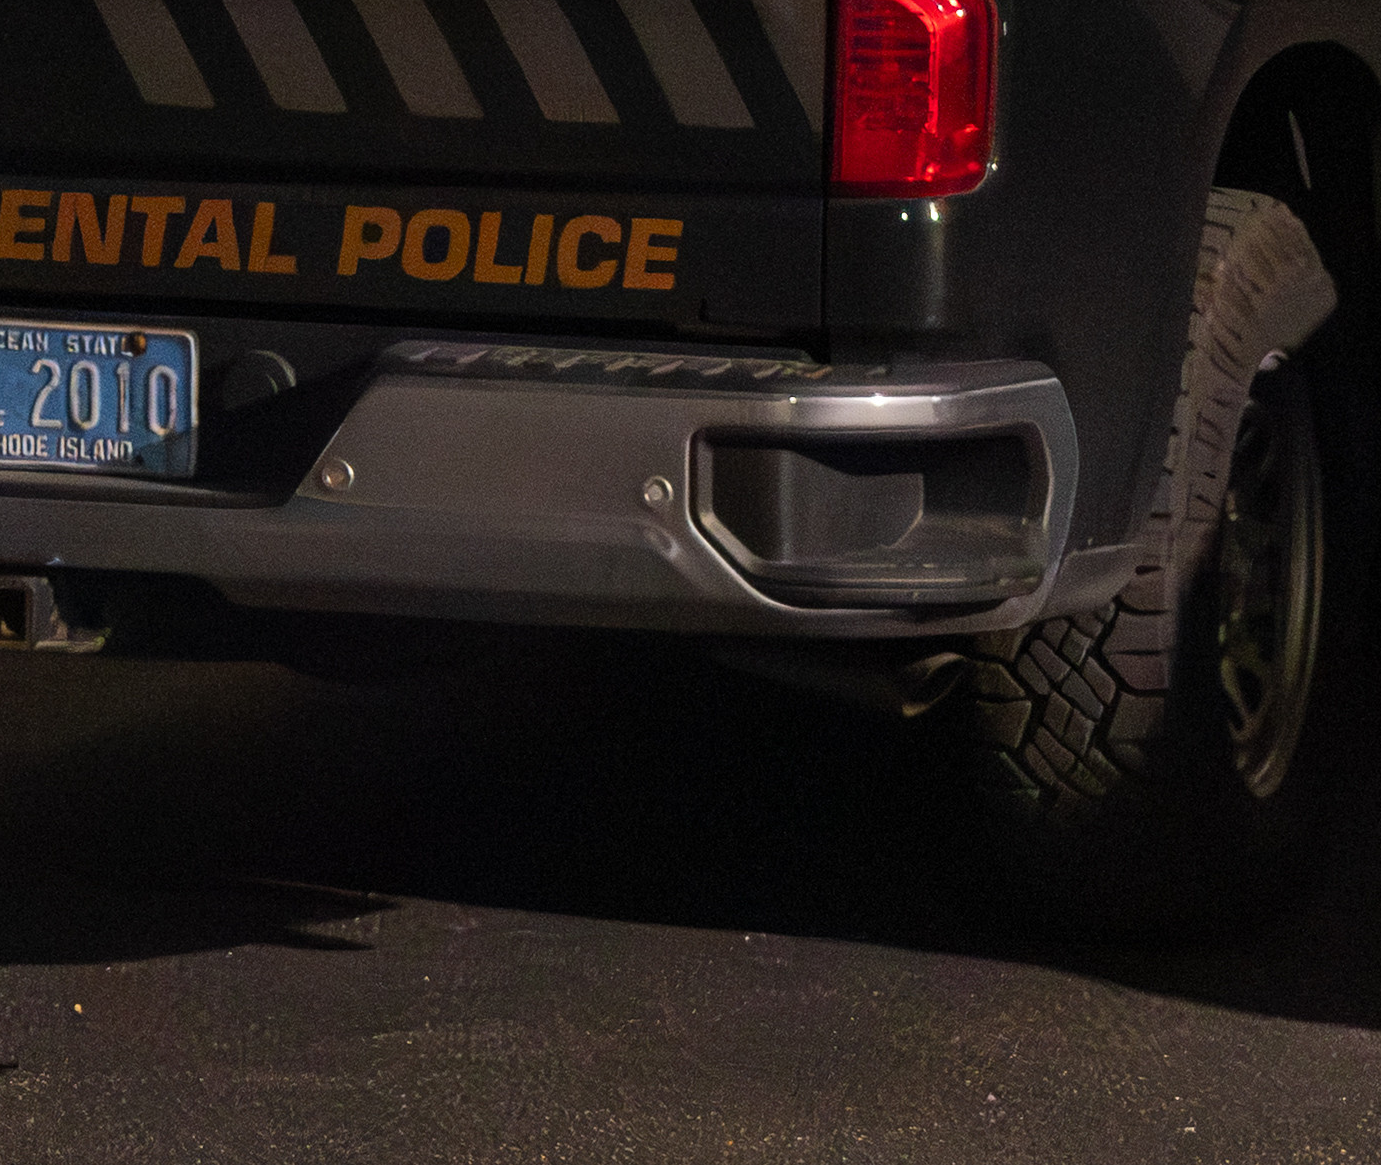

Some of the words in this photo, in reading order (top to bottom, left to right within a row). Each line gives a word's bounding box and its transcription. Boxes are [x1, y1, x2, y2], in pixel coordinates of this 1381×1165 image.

[335, 204, 685, 291] POLICE
[29, 359, 178, 437] 2010
[59, 436, 134, 463] ISLAND
